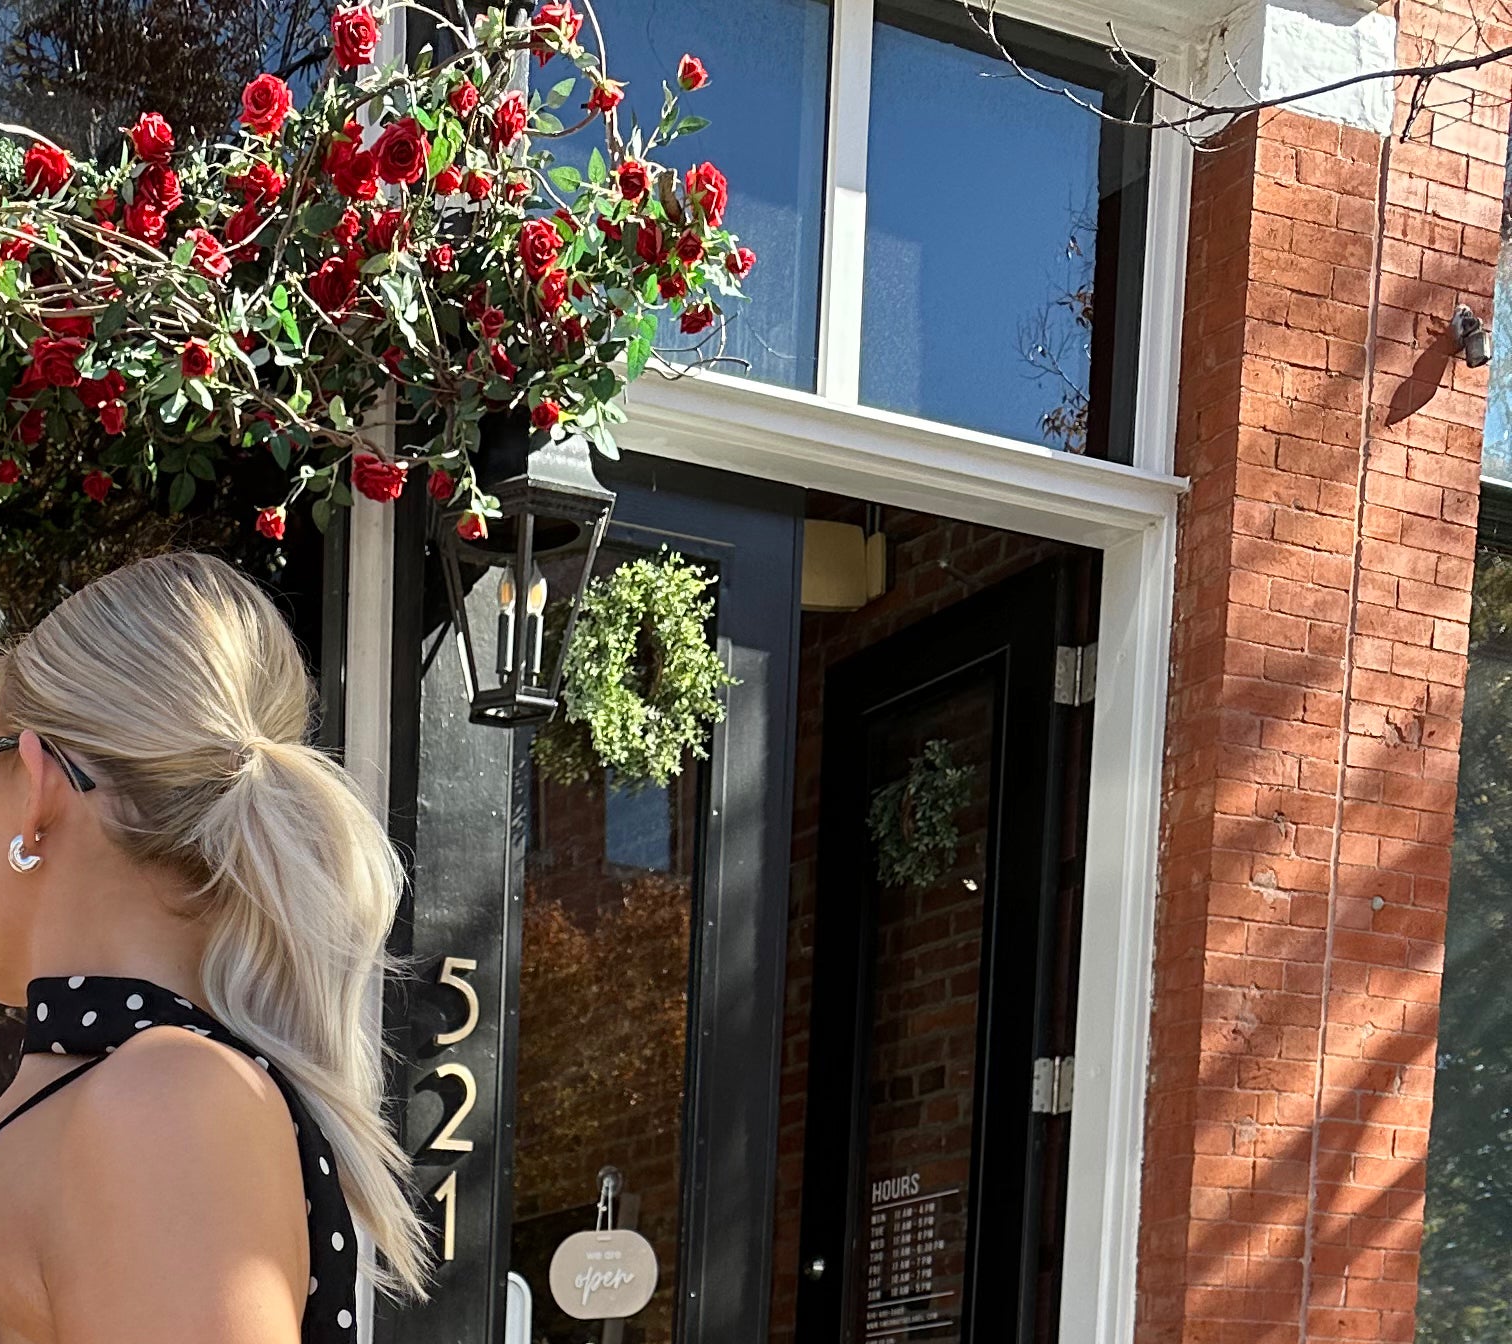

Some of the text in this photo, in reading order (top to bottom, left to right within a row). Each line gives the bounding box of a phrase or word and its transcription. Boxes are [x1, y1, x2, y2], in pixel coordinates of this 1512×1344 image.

[430, 956, 480, 1261] 521
[872, 1174, 920, 1203] HOURS
[586, 1250, 622, 1260] we are
[574, 1266, 635, 1306] open
